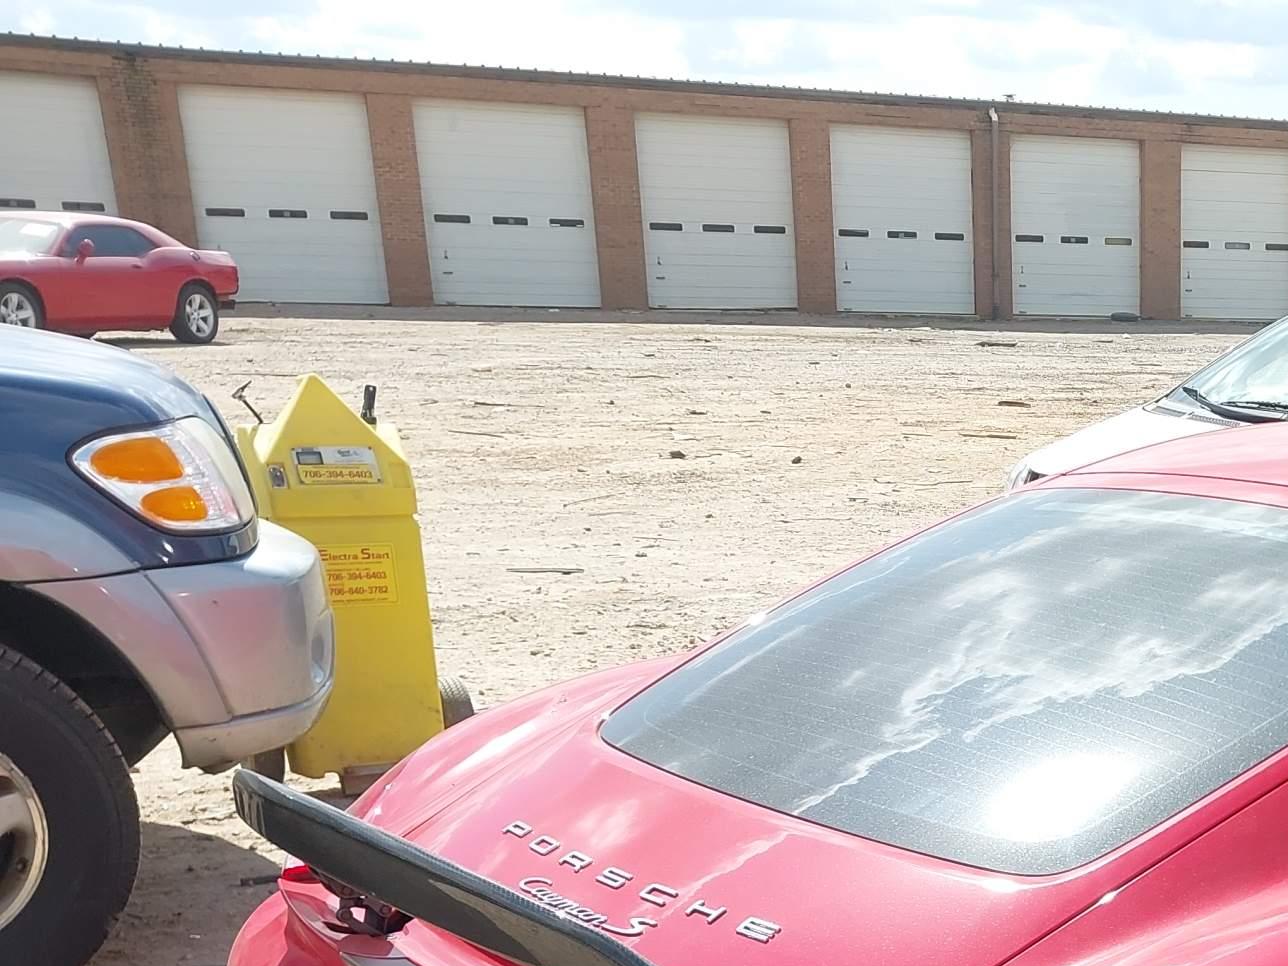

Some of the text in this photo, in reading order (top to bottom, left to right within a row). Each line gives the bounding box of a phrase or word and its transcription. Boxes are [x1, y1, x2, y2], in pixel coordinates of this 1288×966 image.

[303, 470, 373, 479] 706-394-6403
[319, 548, 390, 561] Electra Start
[327, 571, 387, 582] 706-394-6403
[502, 820, 782, 944] PORSCHE
[519, 876, 609, 927] Cayman
